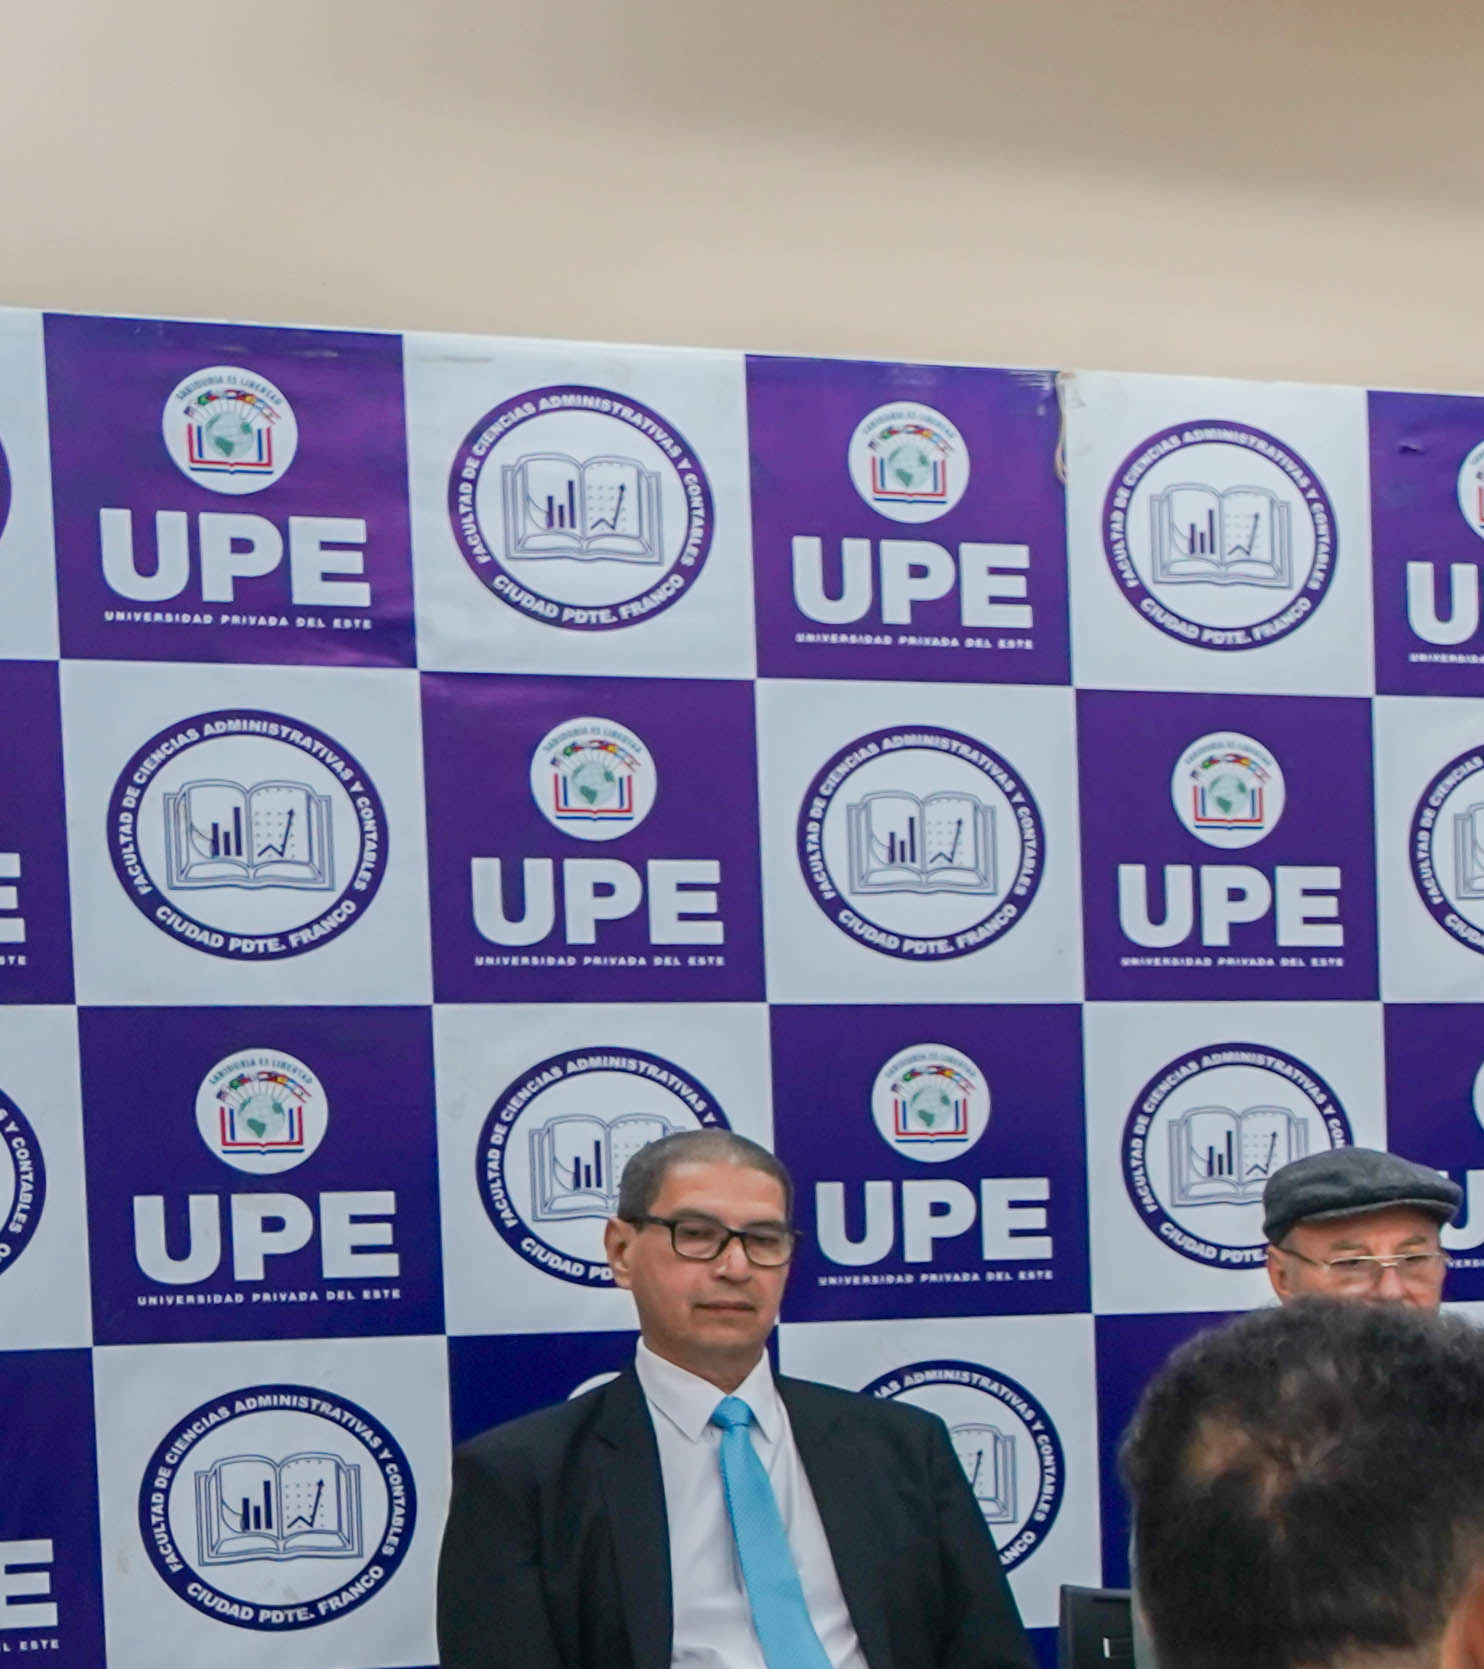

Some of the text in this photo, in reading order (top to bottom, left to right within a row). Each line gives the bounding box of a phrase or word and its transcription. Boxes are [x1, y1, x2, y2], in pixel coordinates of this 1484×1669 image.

[473, 402, 536, 456] CIENCIAS
[539, 395, 681, 458] ADMINISTRATIVAS
[463, 457, 479, 479] DE
[460, 482, 490, 564] FACULTAD
[682, 474, 704, 565] CONTABLES
[100, 508, 370, 606] UPE
[793, 536, 1032, 628] UPE
[495, 574, 683, 623] CIUDAD PDTE. FRANCO
[134, 728, 199, 784] CIENCIAS
[204, 719, 353, 781] ADMINISTRATIVAS
[123, 786, 140, 808] DE
[120, 812, 151, 895] FACULTAD
[354, 797, 377, 890] CONTABLES
[157, 900, 355, 952] CIUDAD PDTE. FRANCO
[472, 858, 723, 945] UPE
[1119, 864, 1343, 947] UPE
[134, 1192, 399, 1284] UPE
[816, 1178, 1051, 1265] UPE
[166, 1407, 230, 1464] CIENCIAS
[235, 1395, 381, 1448] ADMINISTRATIVAS
[154, 1466, 173, 1489] DE
[382, 1463, 406, 1557] CONTABLES
[152, 1493, 182, 1572] FACULTAD
[188, 1566, 383, 1622] CIUDAD PDTE. FRANCO
